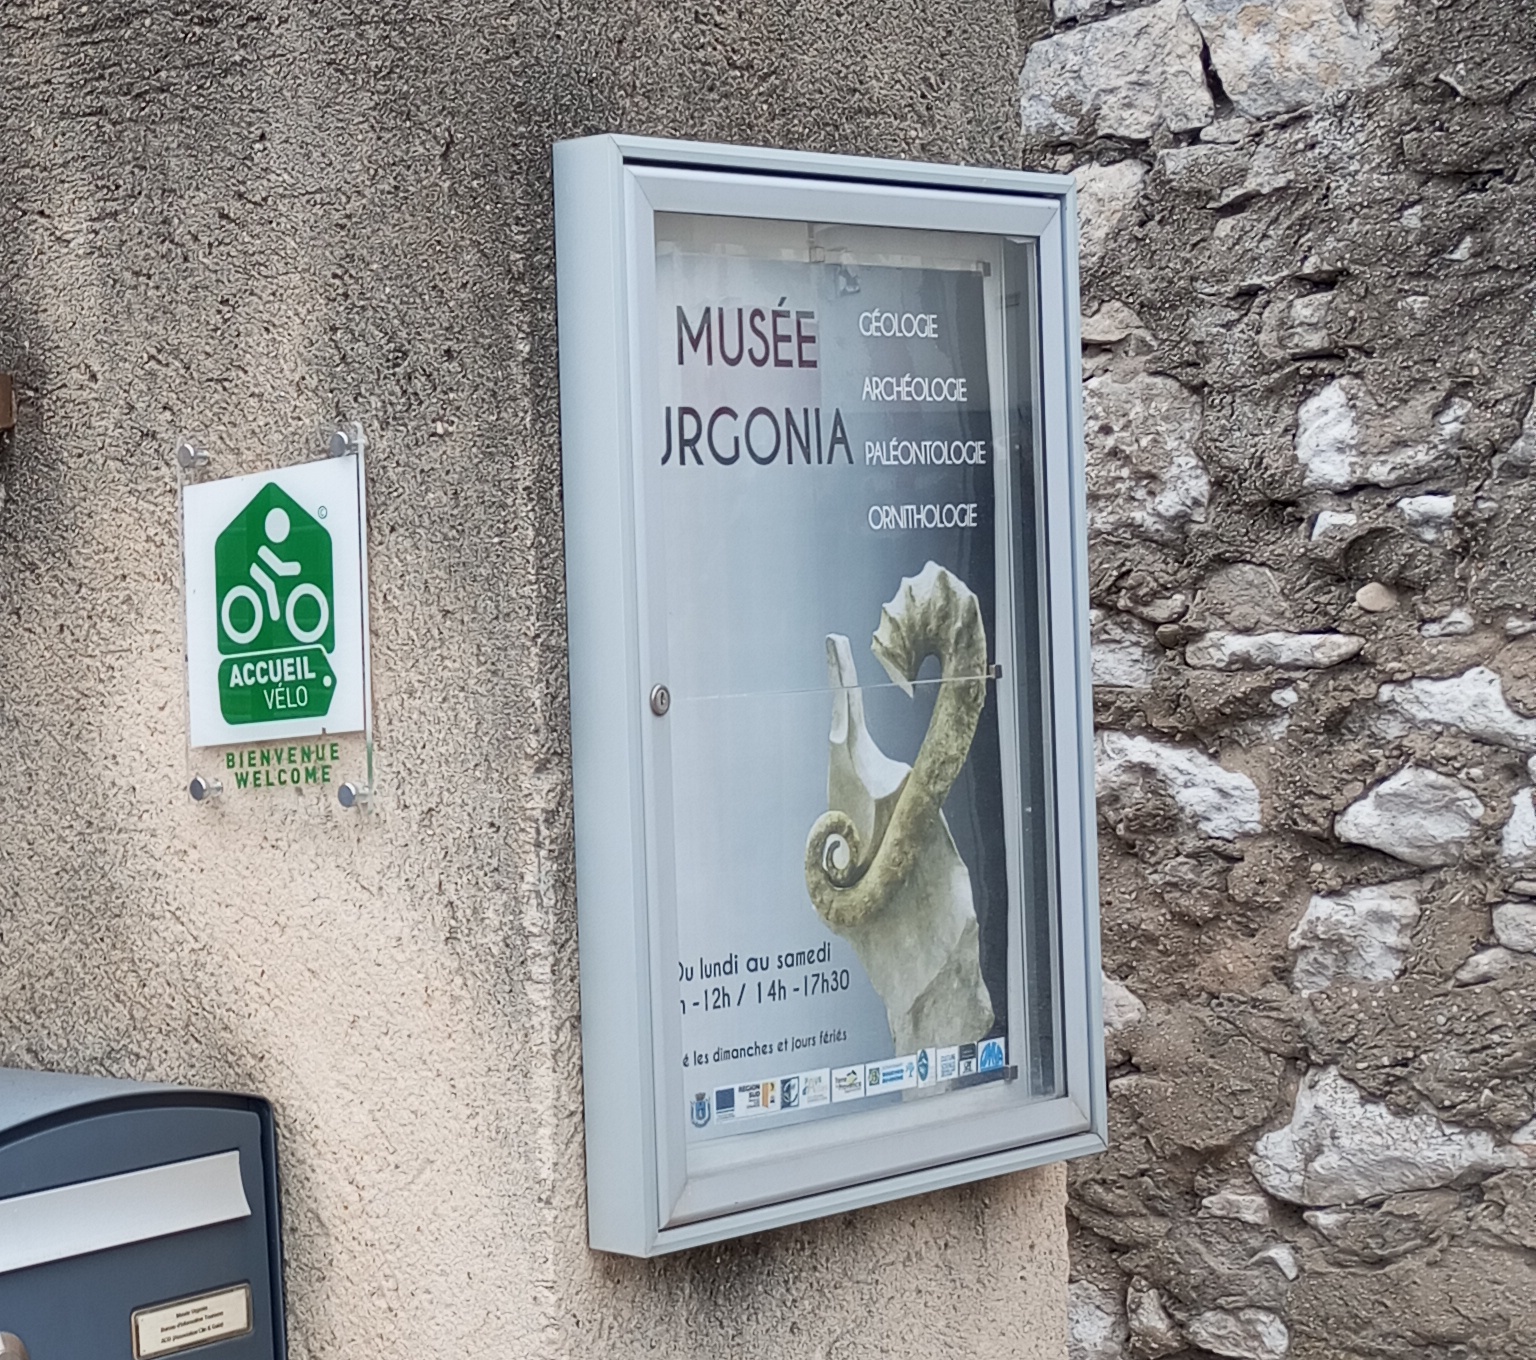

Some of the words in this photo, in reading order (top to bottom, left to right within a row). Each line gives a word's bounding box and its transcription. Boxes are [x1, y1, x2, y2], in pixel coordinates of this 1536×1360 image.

[676, 297, 818, 368] MUSÉE
[859, 308, 938, 338] GÉOLOGIE
[862, 373, 967, 402] ARCHÉOLOGIE
[865, 437, 986, 465] PALÉONTOLOGIE
[868, 503, 978, 530] ORNITHOLOGIE
[229, 656, 316, 688] ACCUEIL
[263, 682, 308, 710] VÉLO
[226, 742, 340, 769] BIENVENUE
[234, 764, 332, 789] WELCOME
[700, 953, 738, 980] lundi
[746, 956, 769, 972] au
[777, 941, 831, 969] samedi
[757, 979, 787, 1004] 14h
[693, 1050, 709, 1066] les
[713, 1041, 773, 1063] dimanches
[777, 1037, 789, 1052] et
[791, 1035, 816, 1052] jours
[819, 1028, 847, 1046] fériés
